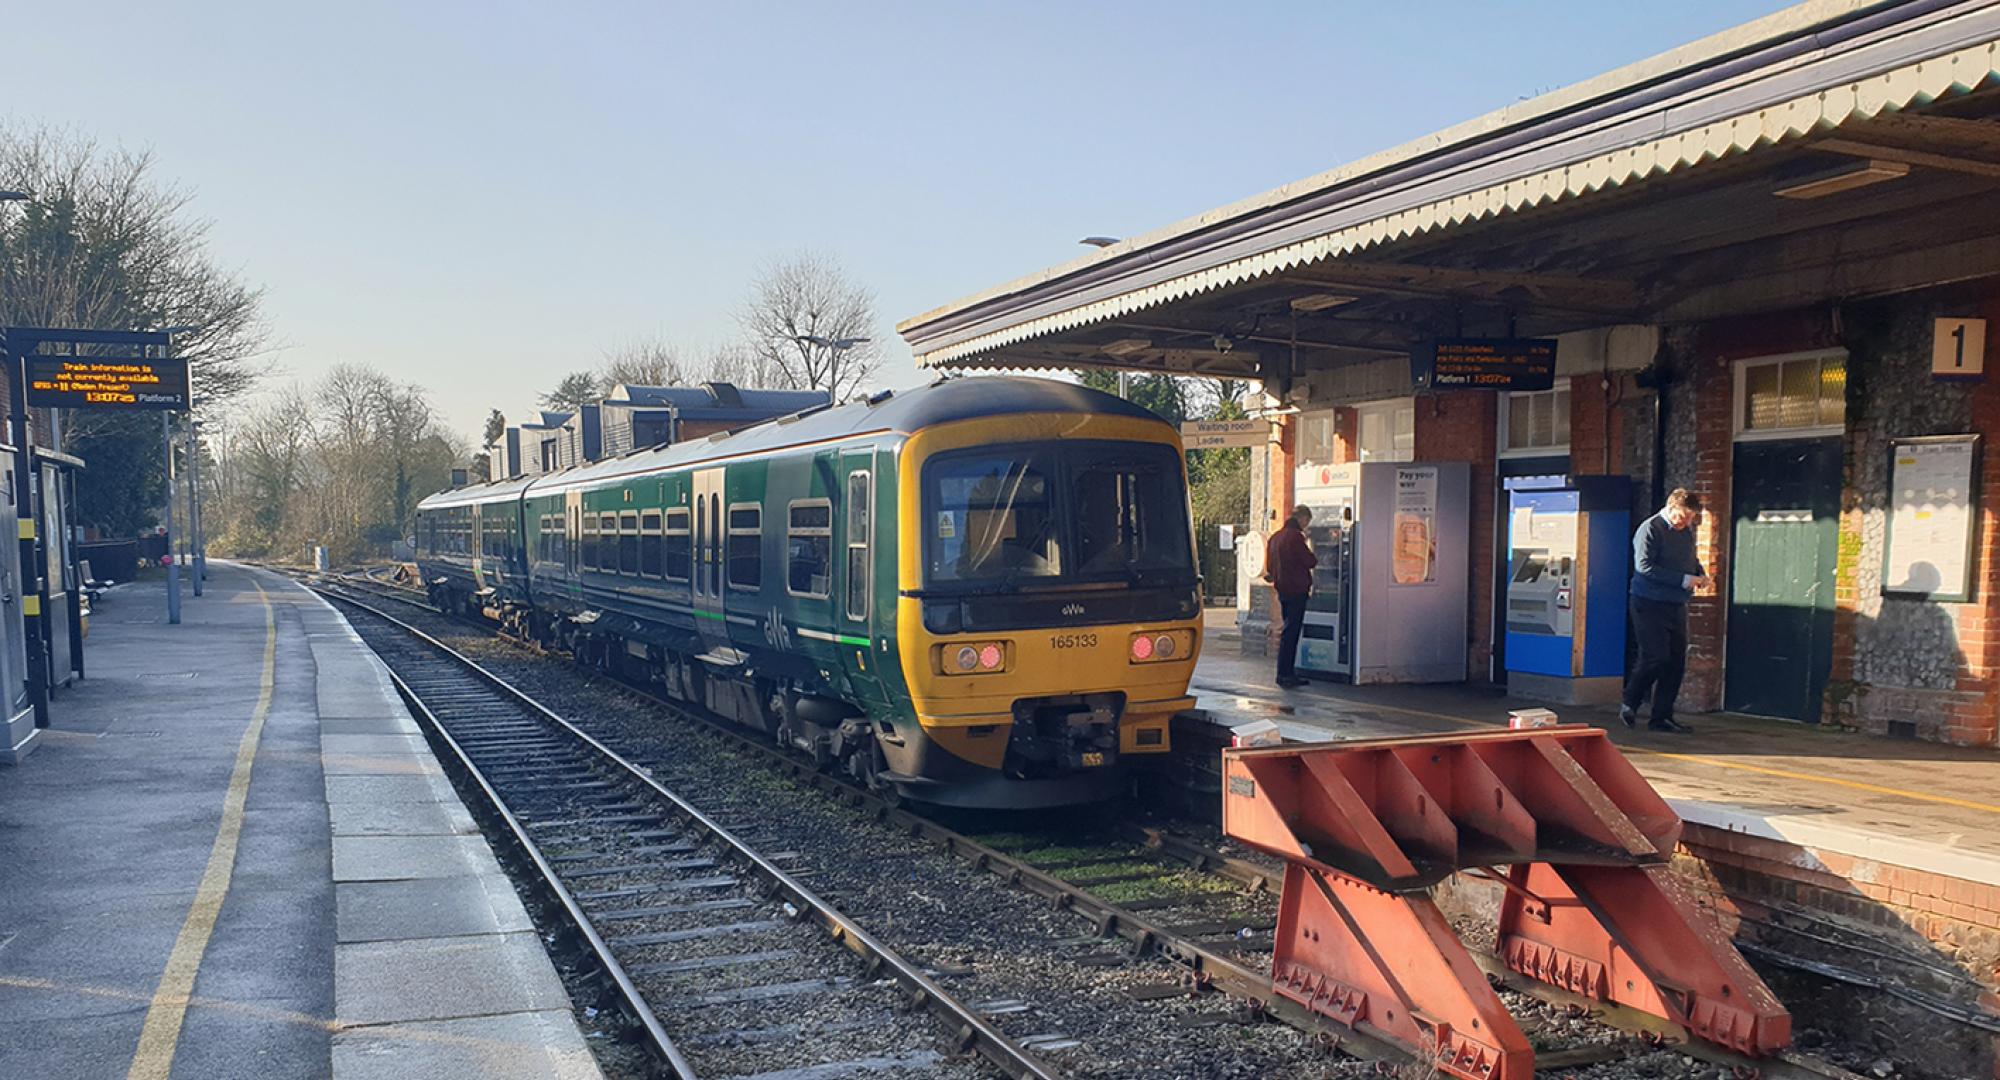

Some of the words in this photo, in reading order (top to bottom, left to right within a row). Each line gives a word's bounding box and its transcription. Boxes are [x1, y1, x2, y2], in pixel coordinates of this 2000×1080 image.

[1951, 324, 1965, 368] 1
[63, 362, 88, 371] Train
[91, 364, 141, 372] information
[142, 364, 151, 373] is
[56, 373, 72, 381] not
[74, 373, 117, 383] currently
[118, 374, 160, 383] available
[1436, 375, 1466, 384] Platform
[1467, 375, 1471, 383] 1
[138, 393, 175, 402] Platform
[176, 394, 182, 403] 2
[1197, 423, 1230, 432] Waiting
[1197, 437, 1225, 446] Ladies
[1399, 471, 1414, 480] Pay
[1415, 472, 1435, 480] your
[1050, 633, 1098, 649] 165133
